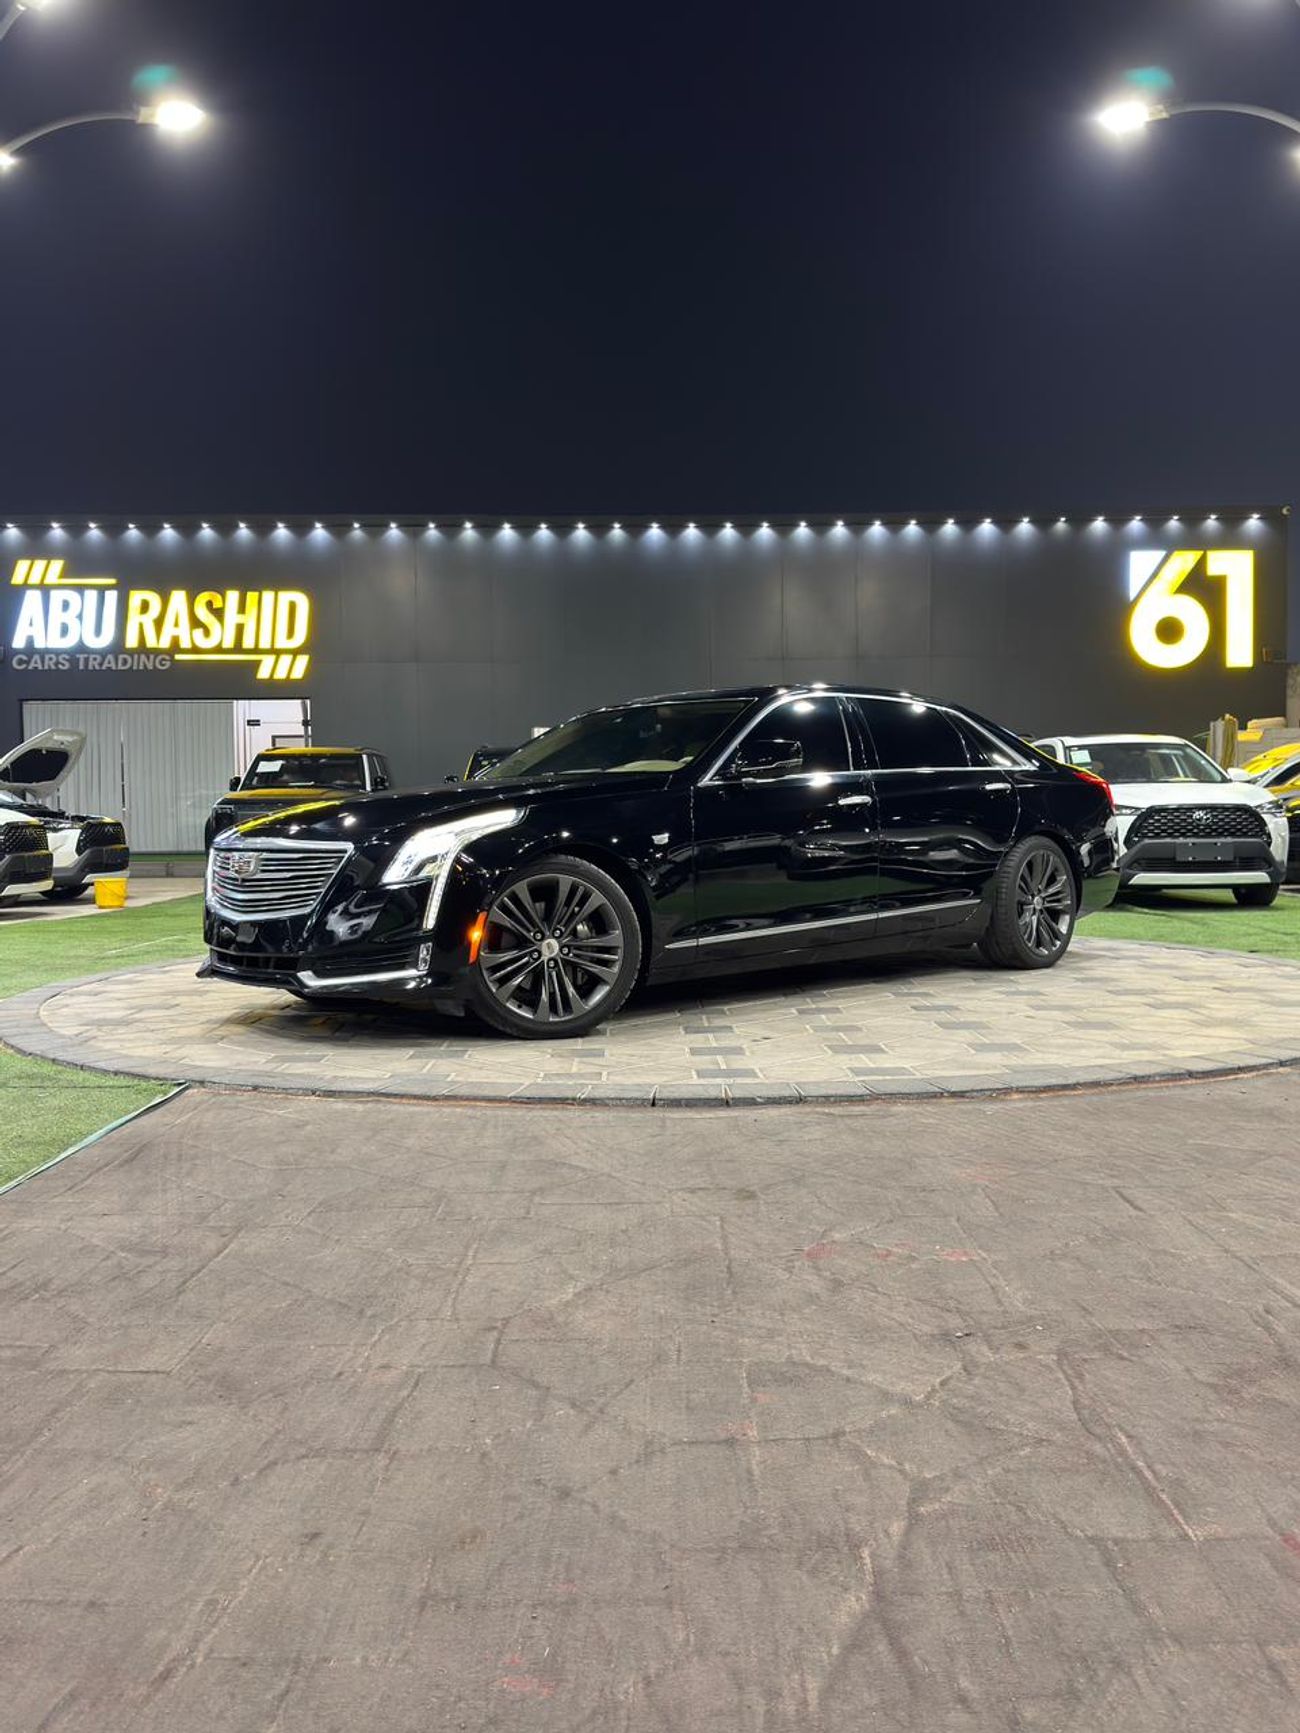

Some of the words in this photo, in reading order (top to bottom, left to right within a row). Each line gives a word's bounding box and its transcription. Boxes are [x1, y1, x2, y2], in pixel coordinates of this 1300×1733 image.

[11, 589, 118, 649] ABU
[125, 590, 311, 650] RASHID
[1129, 549, 1255, 668] 61
[12, 654, 70, 671] CARS
[75, 654, 172, 671] TRADING
